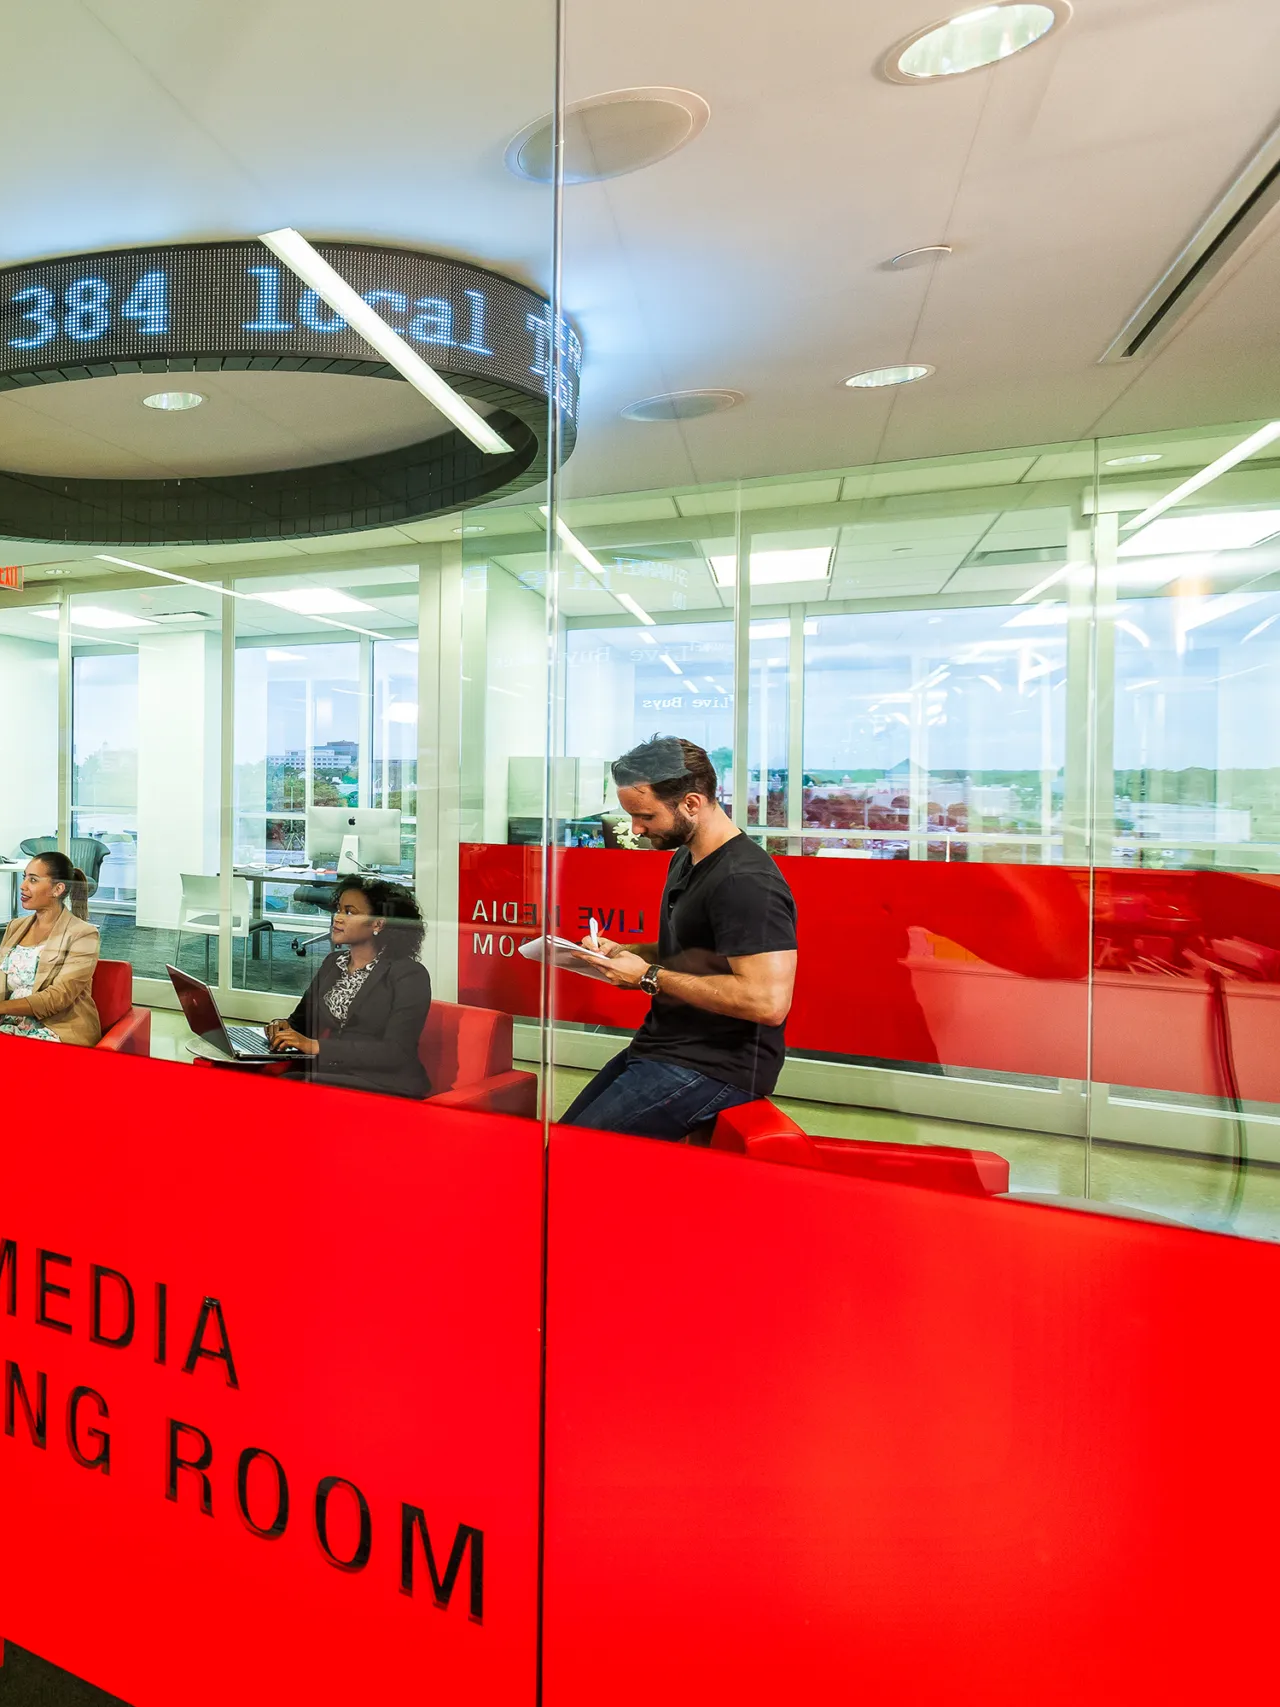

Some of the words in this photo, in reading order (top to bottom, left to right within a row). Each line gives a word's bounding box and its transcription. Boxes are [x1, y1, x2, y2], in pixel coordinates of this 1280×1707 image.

[8, 270, 169, 350] 384
[241, 265, 496, 357] local
[164, 1416, 486, 1627] ROOM
